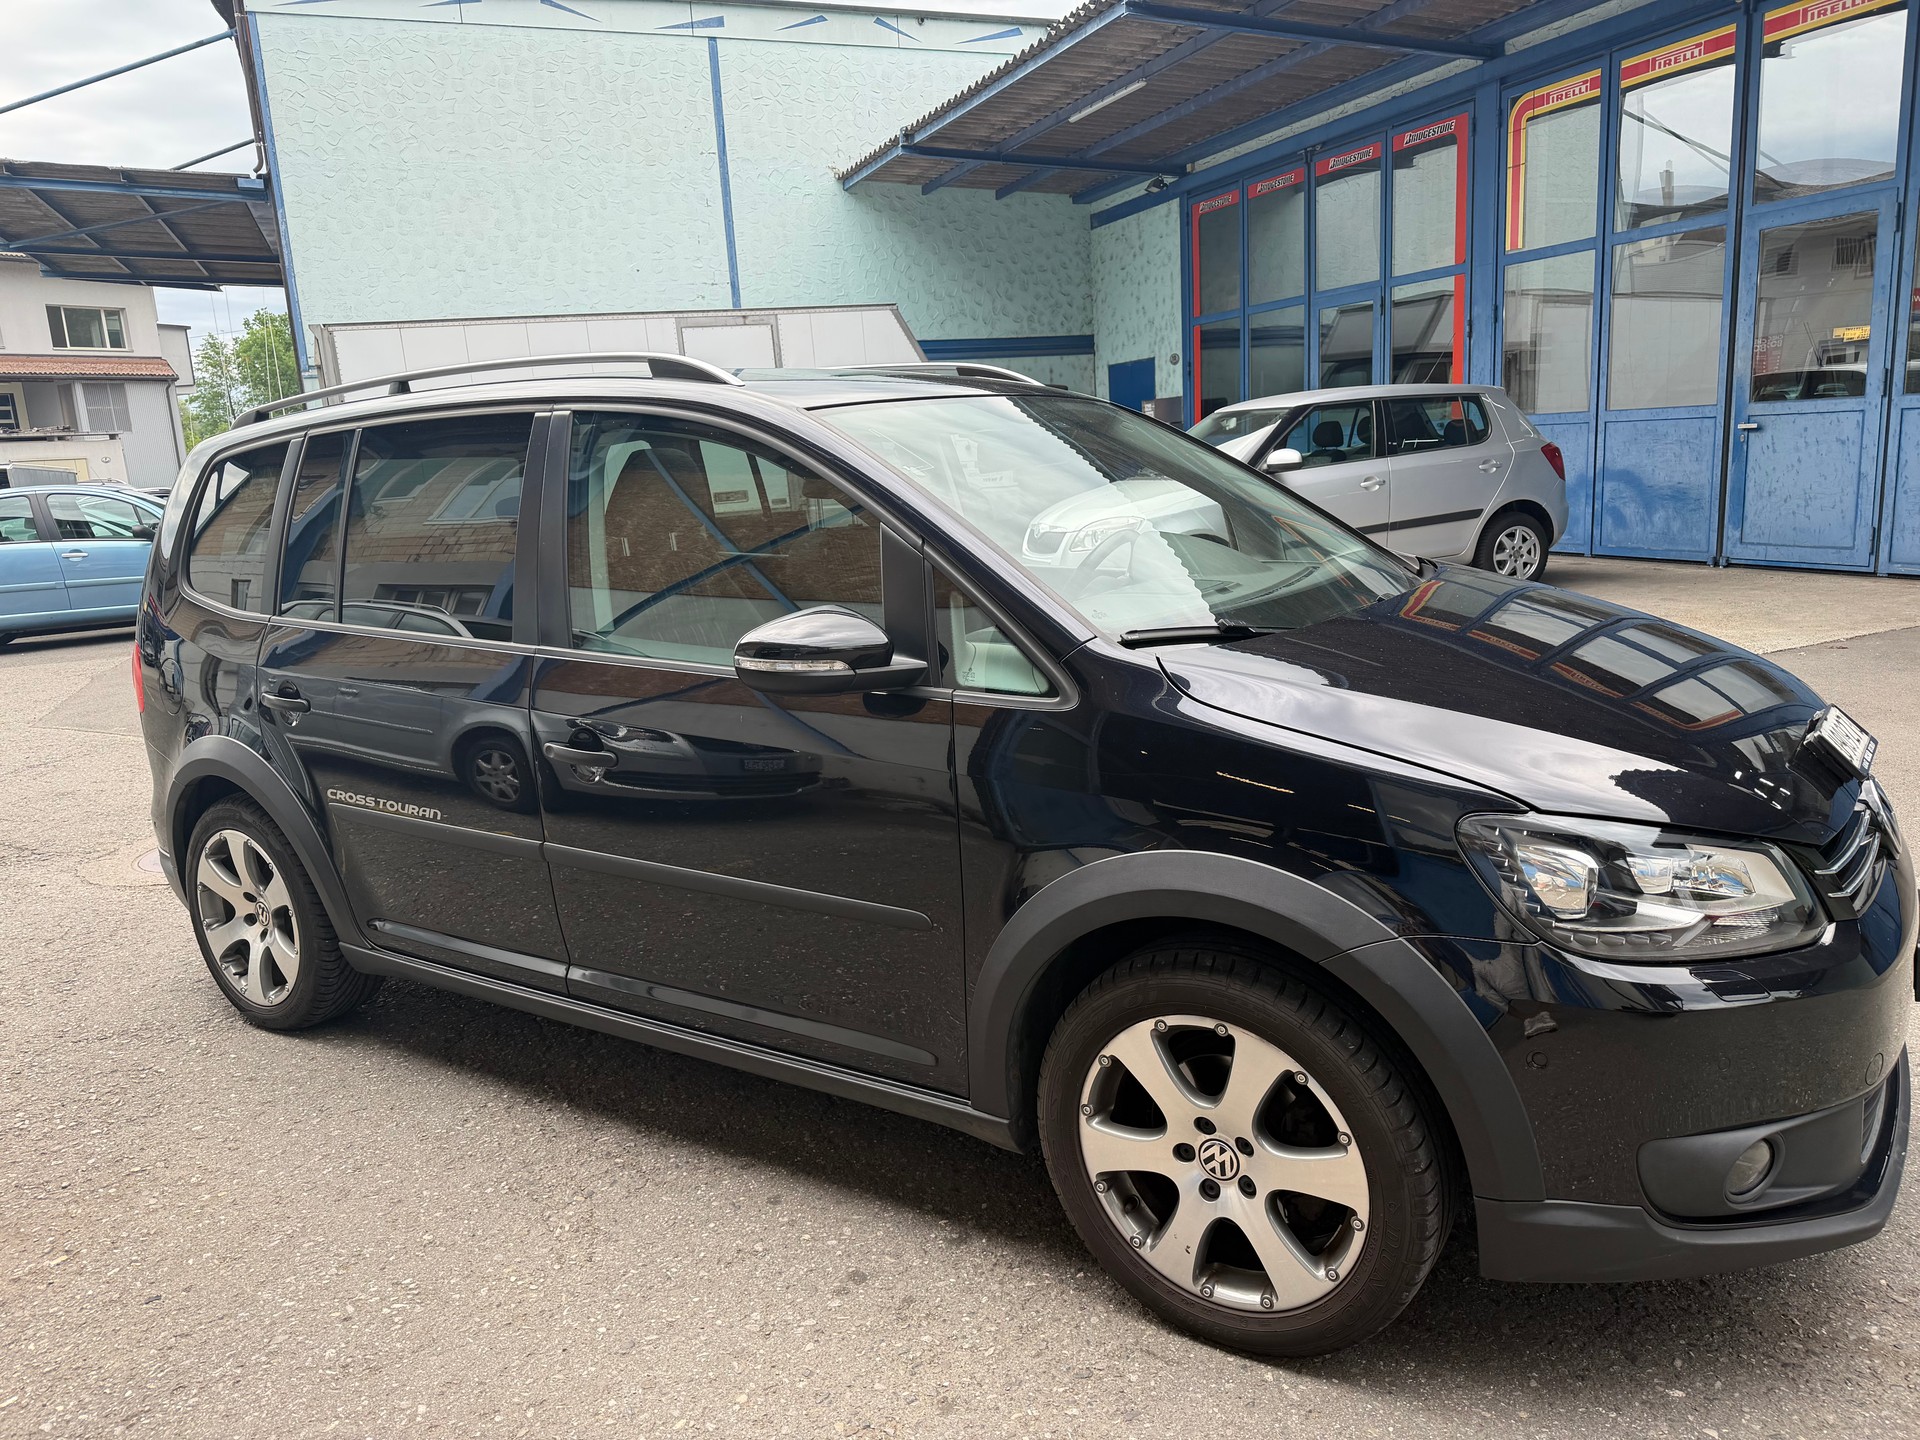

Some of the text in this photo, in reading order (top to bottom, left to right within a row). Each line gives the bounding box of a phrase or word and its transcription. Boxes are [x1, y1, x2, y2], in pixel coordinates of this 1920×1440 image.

[1651, 41, 1704, 71] PIRELLI
[1546, 78, 1590, 105] PIRELLI
[1404, 120, 1456, 146] BRIDGESTONE
[1329, 147, 1374, 170] BRIDGESTONE
[1257, 174, 1295, 194] BRIDGESTONE
[1200, 194, 1232, 213] BRIDGESTONE
